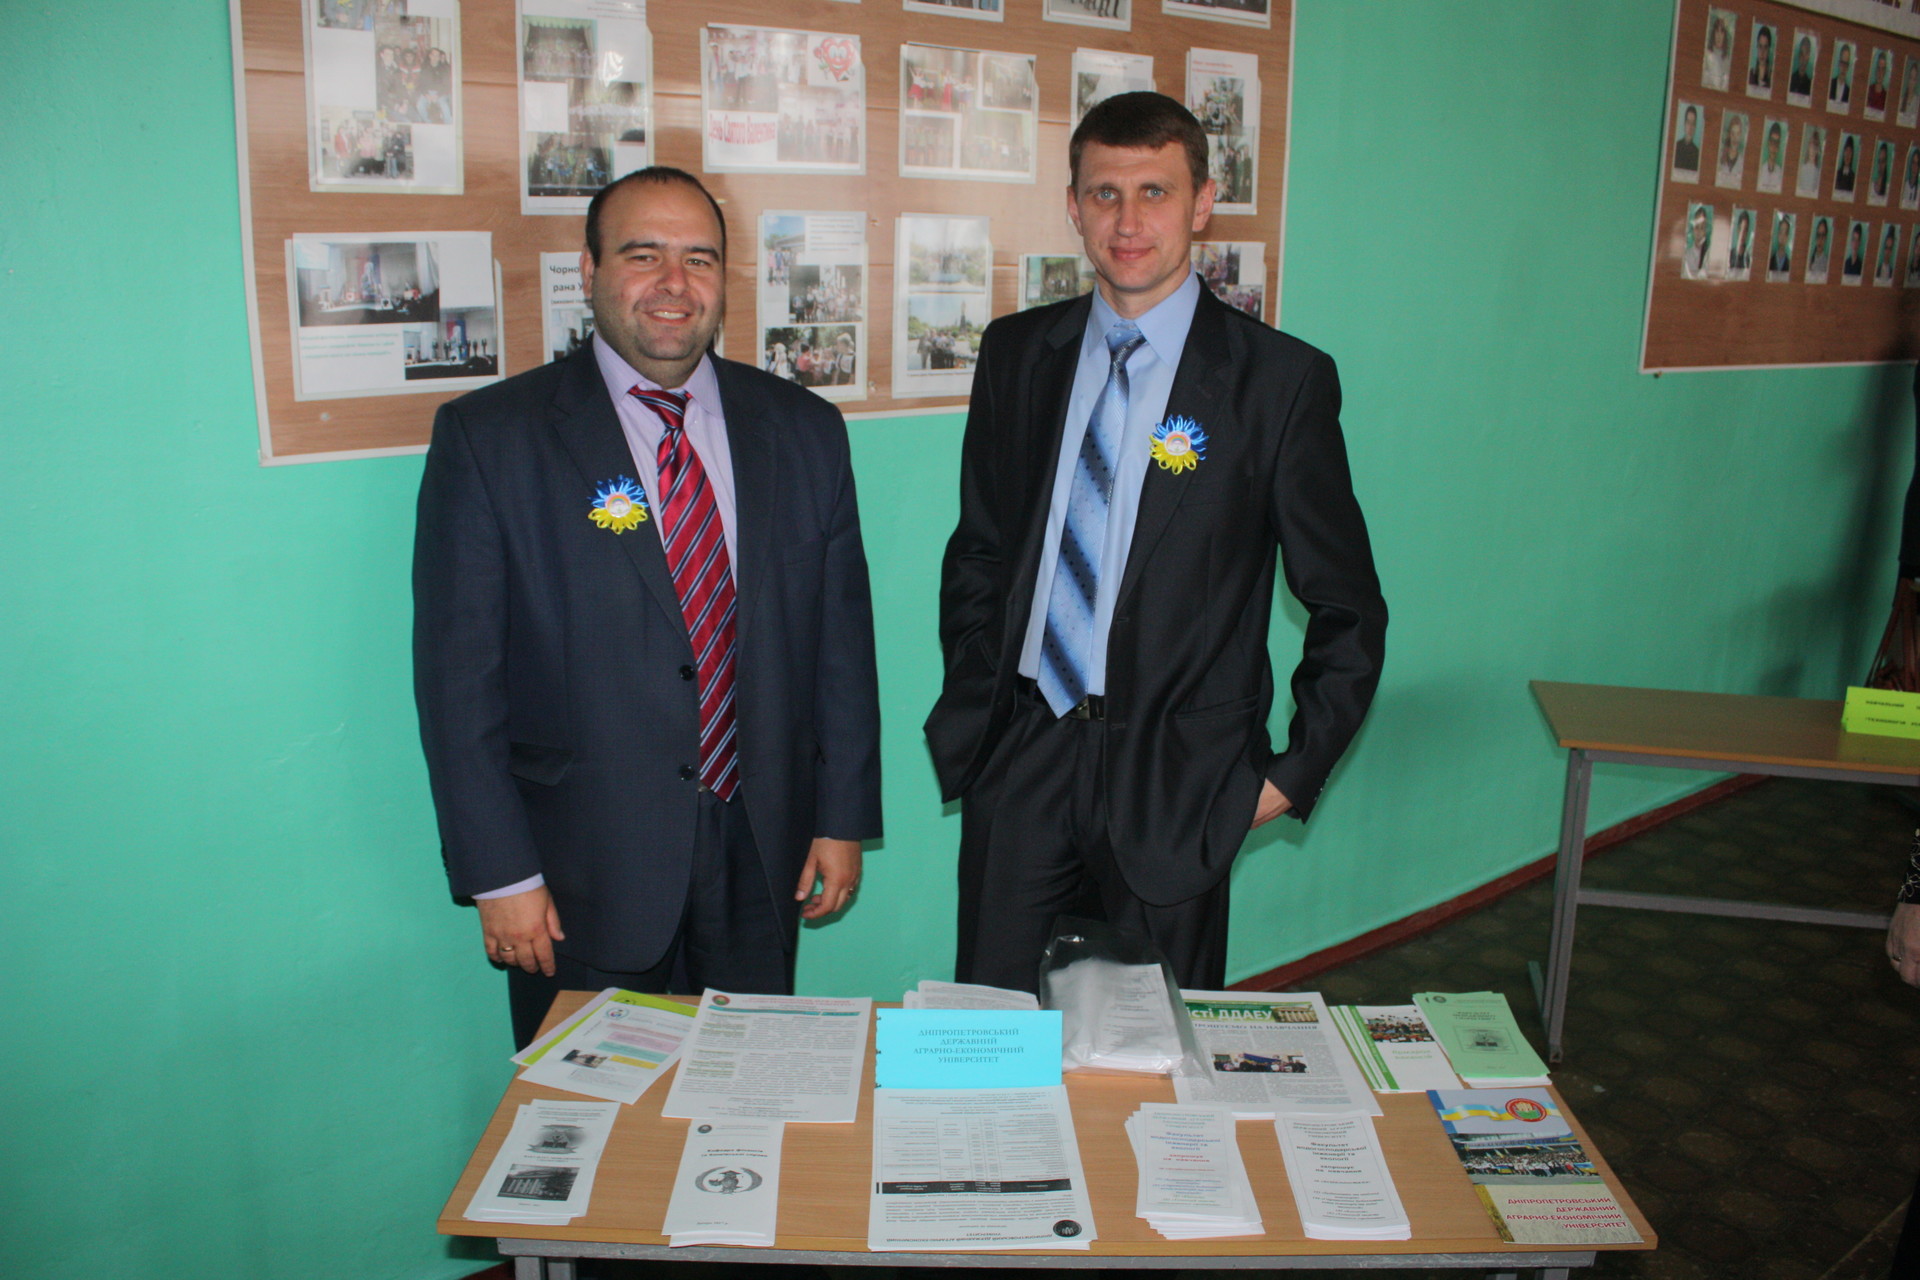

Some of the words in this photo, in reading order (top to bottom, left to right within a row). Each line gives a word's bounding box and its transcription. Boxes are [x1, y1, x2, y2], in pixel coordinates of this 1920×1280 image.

[550, 264, 580, 276] Чорно
[553, 285, 576, 293] рана
[1187, 1007, 1214, 1018] істі
[1218, 1009, 1272, 1021] ДДАЕУ
[918, 1028, 1019, 1036] ДНІПРОПЕТРОВСЬКИЙ
[914, 1046, 1024, 1054] АГРАРНО-ЕКОНОМІЧНИЙ
[1508, 1197, 1611, 1205] ДНІПРОПЕТРОВСЬКИЙ
